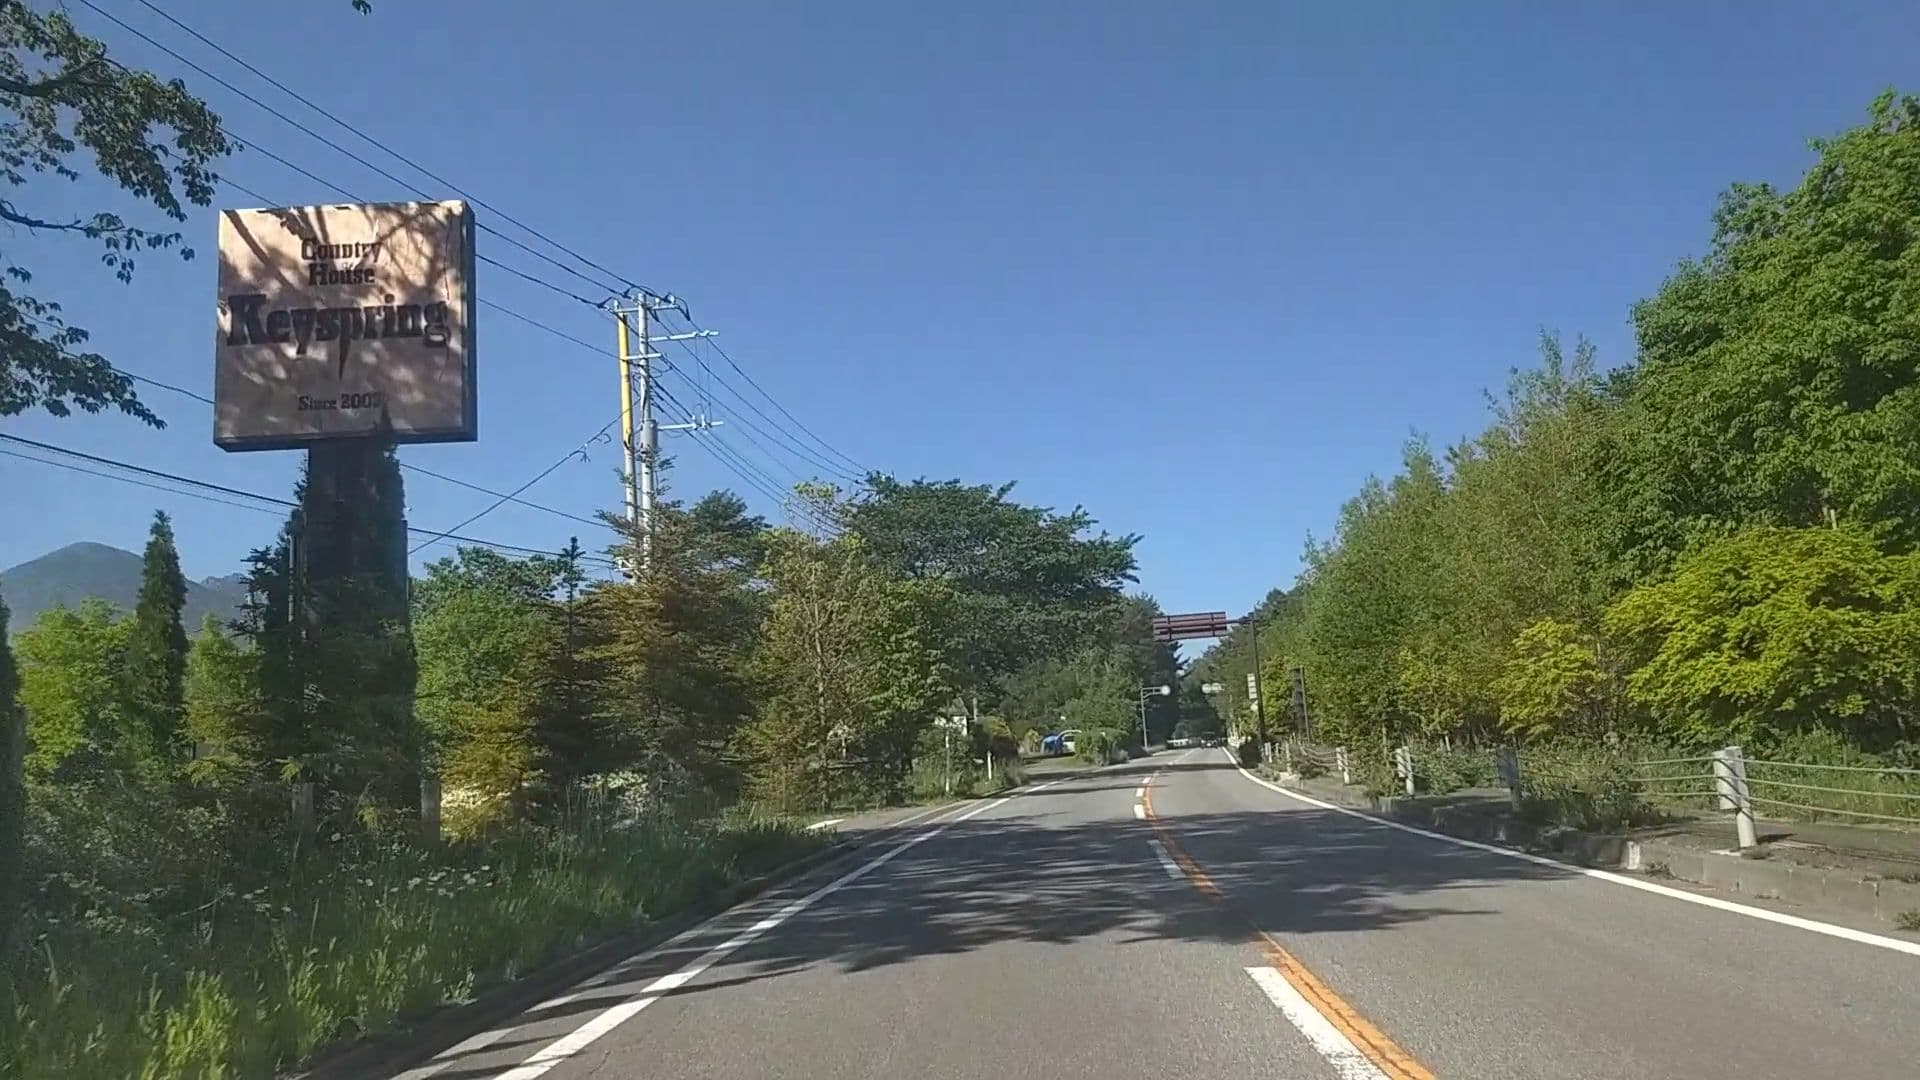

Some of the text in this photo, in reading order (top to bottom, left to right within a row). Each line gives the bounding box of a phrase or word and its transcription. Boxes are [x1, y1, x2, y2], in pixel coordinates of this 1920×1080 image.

[301, 238, 383, 263] Country
[308, 263, 376, 285] House
[227, 293, 451, 381] Keyspring
[297, 395, 337, 411] Since
